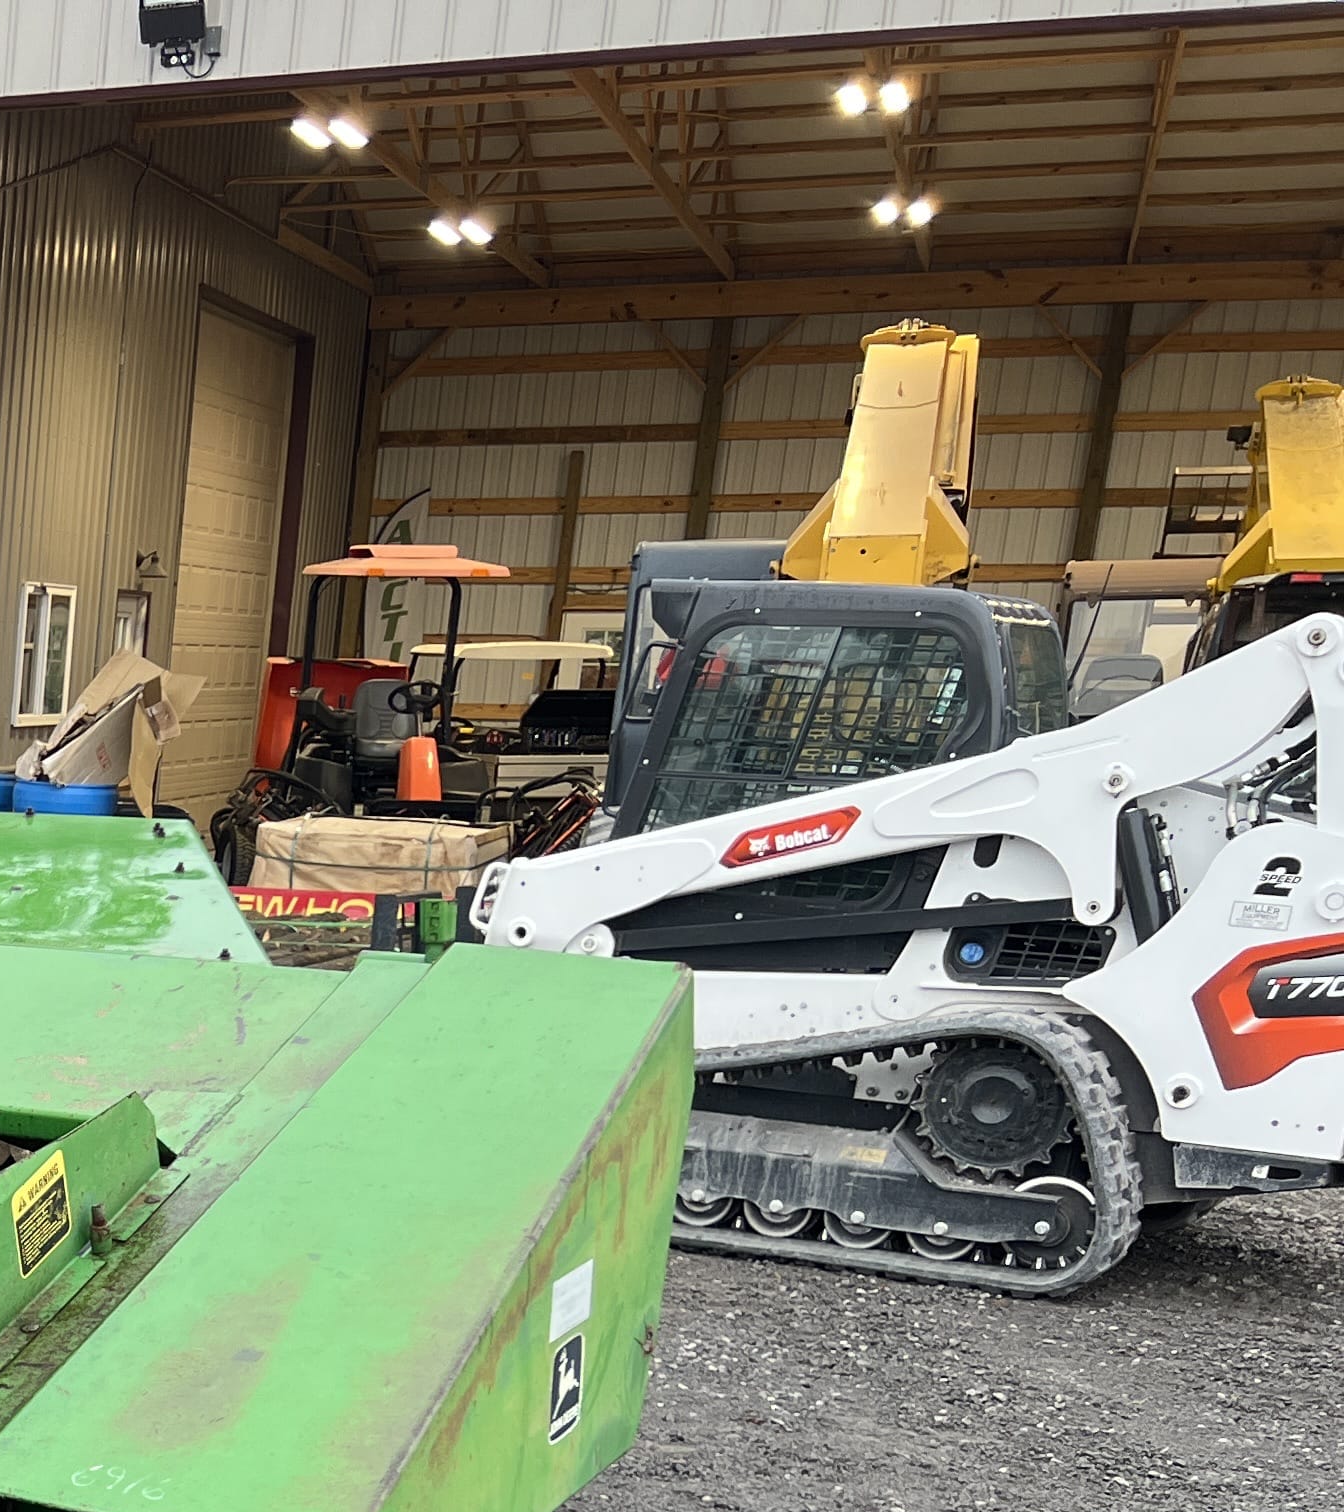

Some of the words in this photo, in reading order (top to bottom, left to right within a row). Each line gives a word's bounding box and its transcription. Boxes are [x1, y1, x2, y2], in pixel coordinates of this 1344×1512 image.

[774, 824, 830, 852] Bobcat
[1253, 856, 1302, 897] 2
[1259, 873, 1302, 884] SPEED
[235, 894, 299, 918] EW
[1243, 903, 1280, 915] MILLER
[27, 1163, 60, 1200] WARNING
